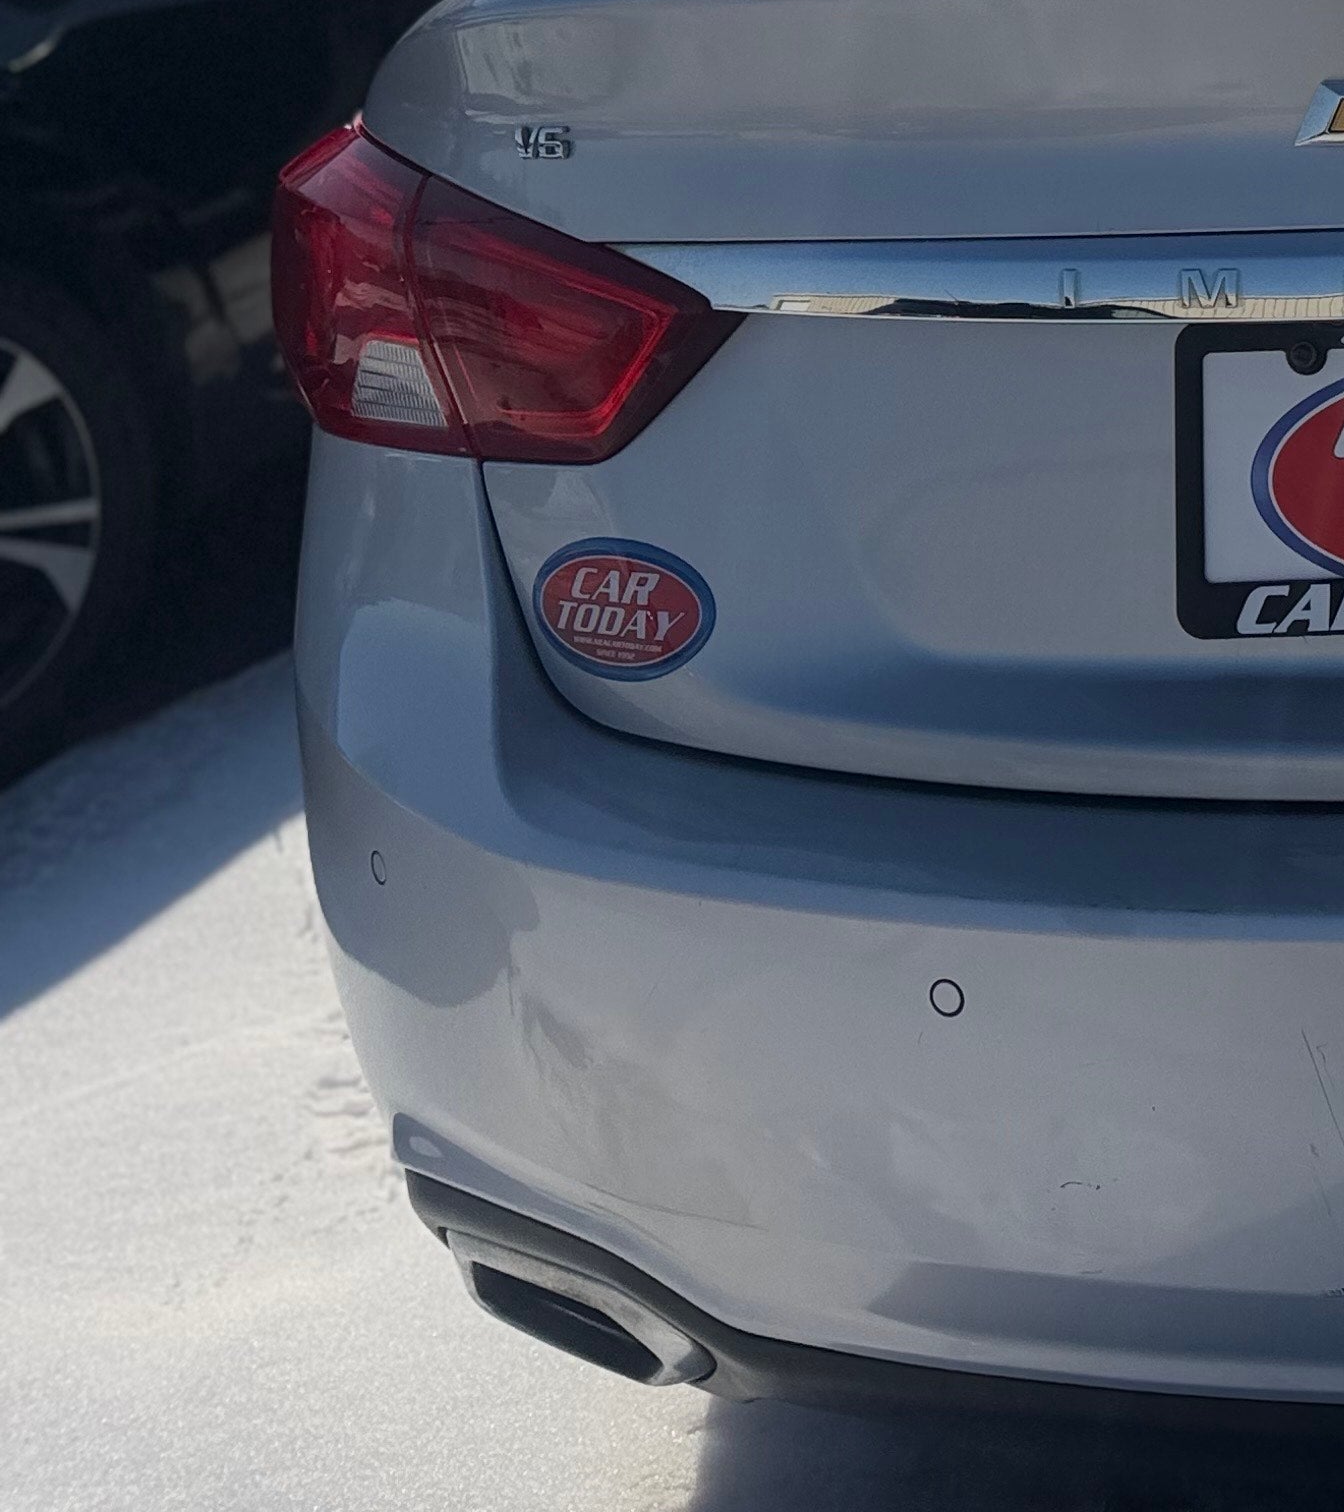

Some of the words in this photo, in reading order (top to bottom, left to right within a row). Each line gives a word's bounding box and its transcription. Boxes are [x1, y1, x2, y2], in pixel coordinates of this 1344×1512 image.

[514, 125, 567, 159] V6
[570, 567, 661, 605] CAR
[556, 600, 686, 641] TODAY
